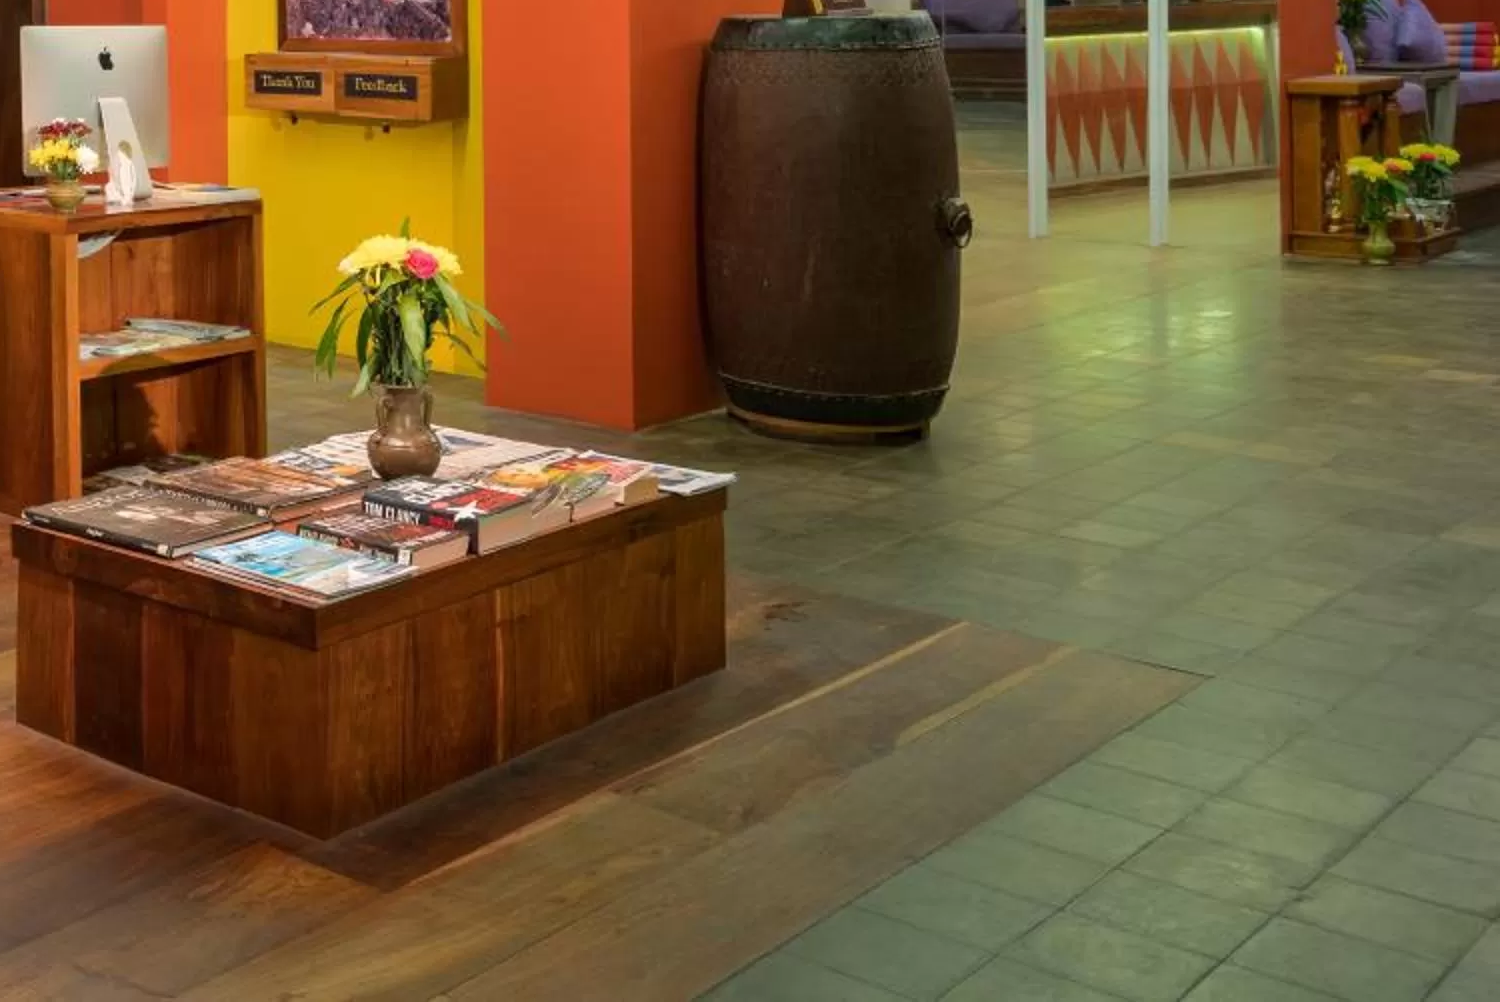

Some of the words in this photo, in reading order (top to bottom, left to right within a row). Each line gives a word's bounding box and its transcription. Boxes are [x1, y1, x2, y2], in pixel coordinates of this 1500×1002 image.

[260, 74, 293, 87] Thank
[294, 75, 316, 89] You
[364, 501, 383, 517] TOM
[385, 505, 420, 526] CLANCY
